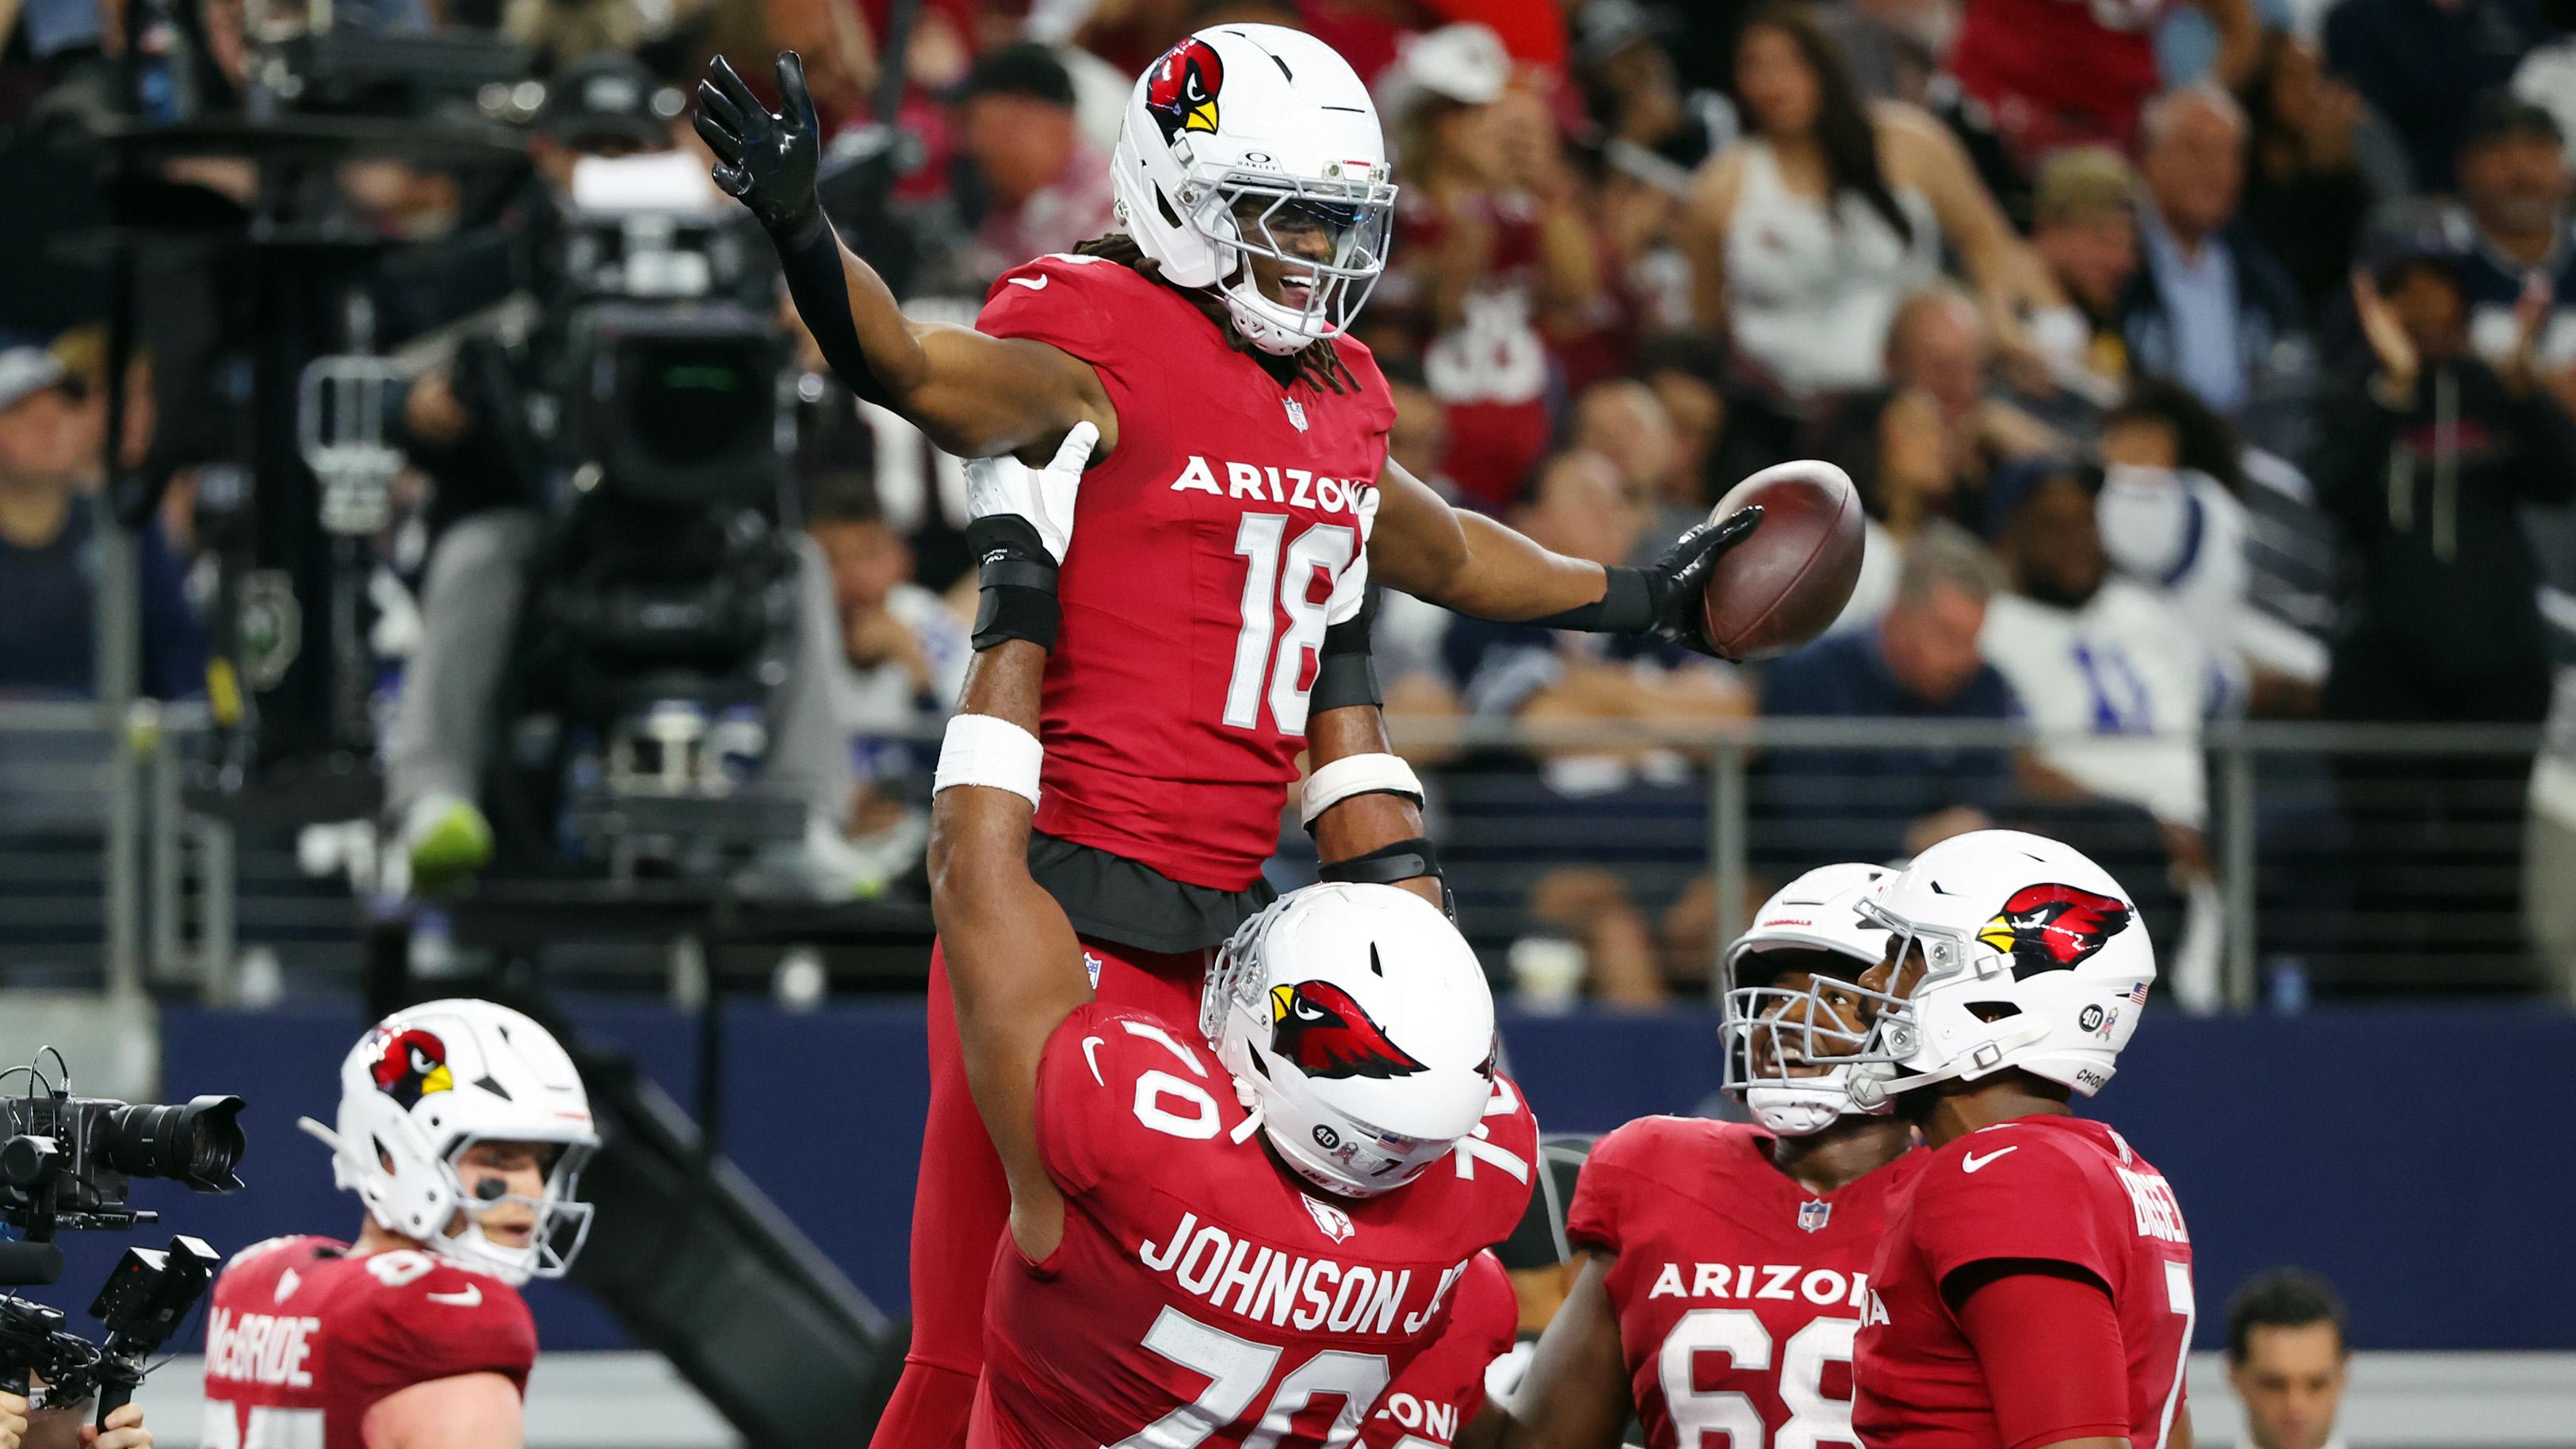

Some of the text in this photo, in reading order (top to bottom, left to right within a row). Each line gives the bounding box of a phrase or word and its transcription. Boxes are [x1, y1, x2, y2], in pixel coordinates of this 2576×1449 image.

[1237, 161, 1278, 171] OAKLEY
[1170, 455, 1358, 514] ARIZON
[1222, 511, 1354, 736] 18
[2081, 1008, 2100, 1028] 40
[1316, 1127, 1336, 1146] 40
[1139, 1211, 1411, 1334] JOHNSON
[205, 1306, 321, 1387] McBRIDE
[1097, 1304, 1391, 1449] 70
[1657, 1308, 1865, 1449] 68
